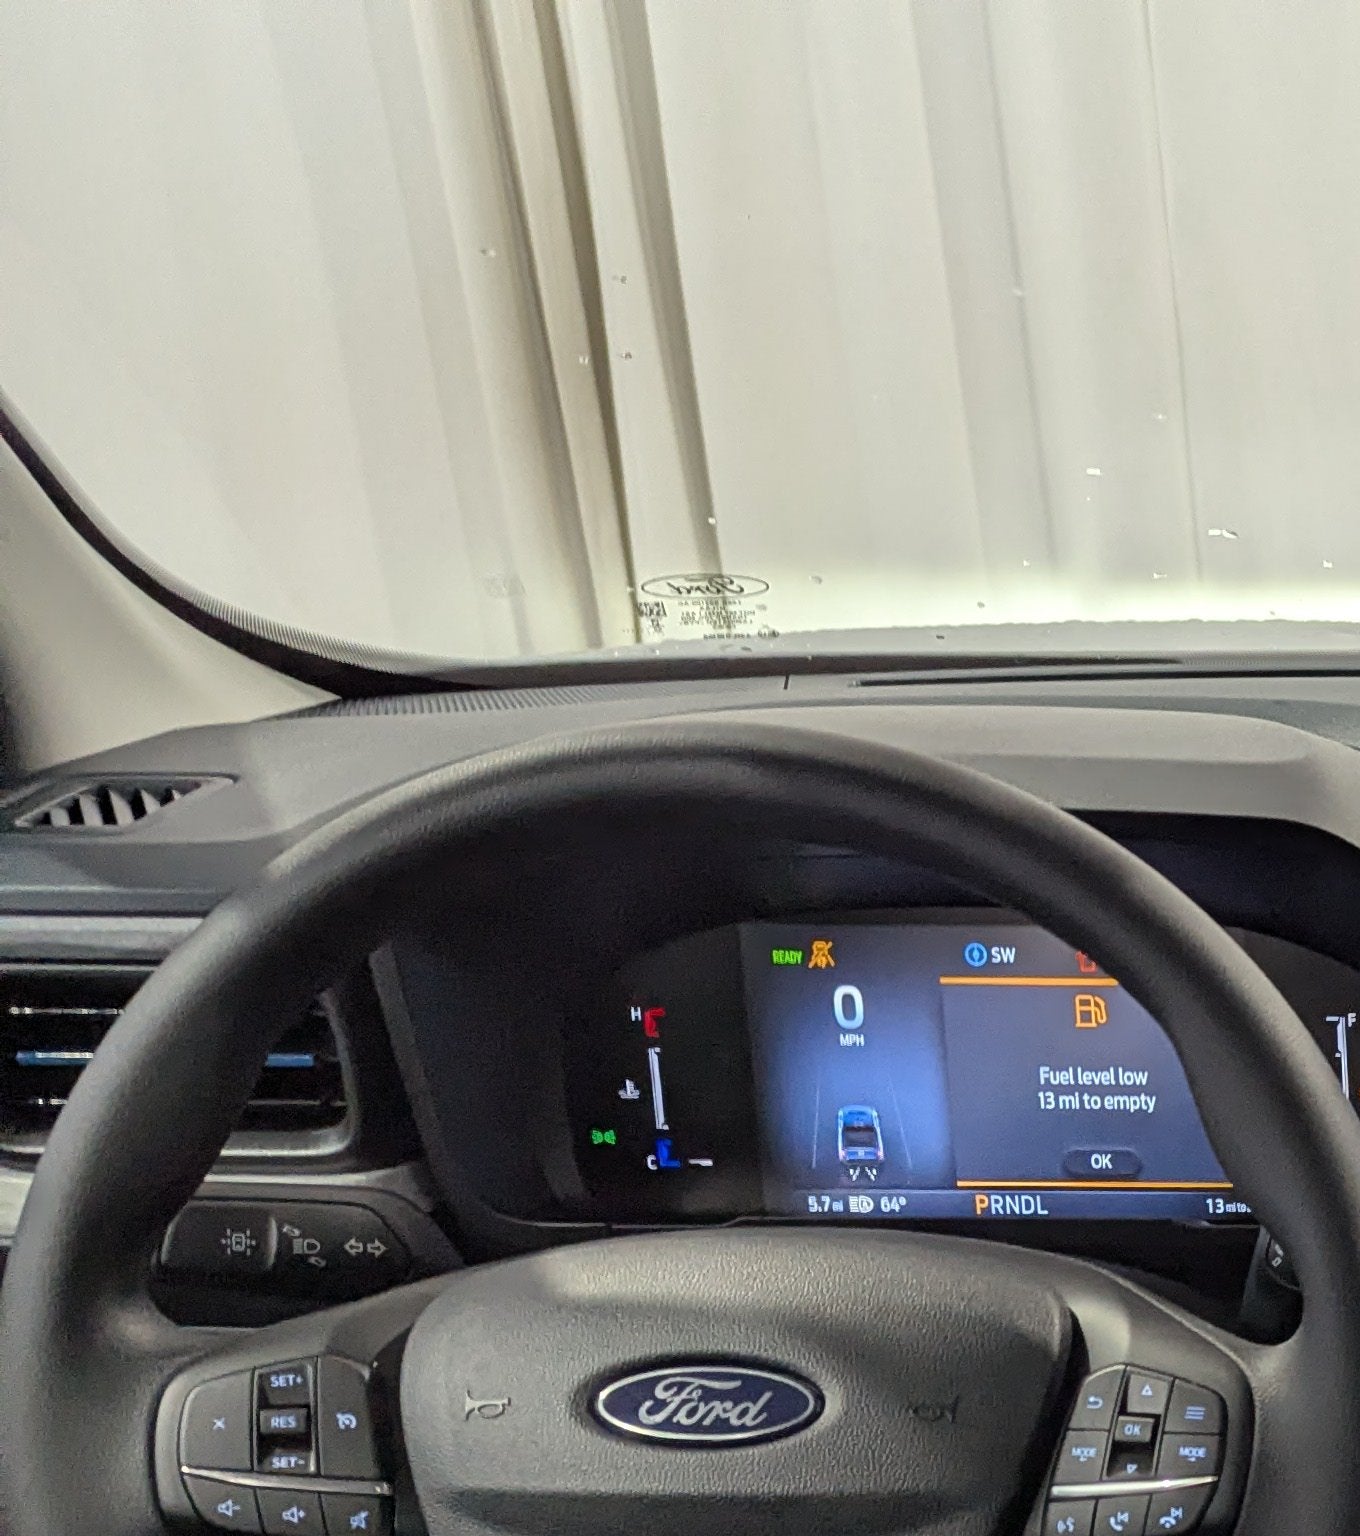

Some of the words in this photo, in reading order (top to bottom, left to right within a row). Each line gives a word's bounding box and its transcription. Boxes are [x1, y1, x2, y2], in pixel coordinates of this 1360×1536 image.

[772, 950, 802, 964] READY
[991, 947, 1015, 963] SW
[631, 1006, 641, 1021] H
[833, 984, 864, 1030] 0
[1347, 1012, 1357, 1028] F
[840, 1034, 864, 1047] MPH
[1039, 1067, 1074, 1086] Fuel
[1078, 1067, 1113, 1086] level
[1117, 1067, 1149, 1087] low
[1038, 1092, 1055, 1111] 13
[1058, 1092, 1080, 1111] mi
[1083, 1093, 1101, 1111] to
[1104, 1093, 1156, 1114] empty
[647, 1155, 657, 1170] C
[1091, 1154, 1112, 1170] OK
[975, 1194, 1049, 1215] PRNDL
[1206, 1198, 1224, 1214] 13
[270, 1374, 304, 1388] SET+
[638, 1376, 772, 1427] Ford
[270, 1415, 296, 1428] RES
[1124, 1424, 1142, 1435] OK
[1179, 1447, 1206, 1458] MODE
